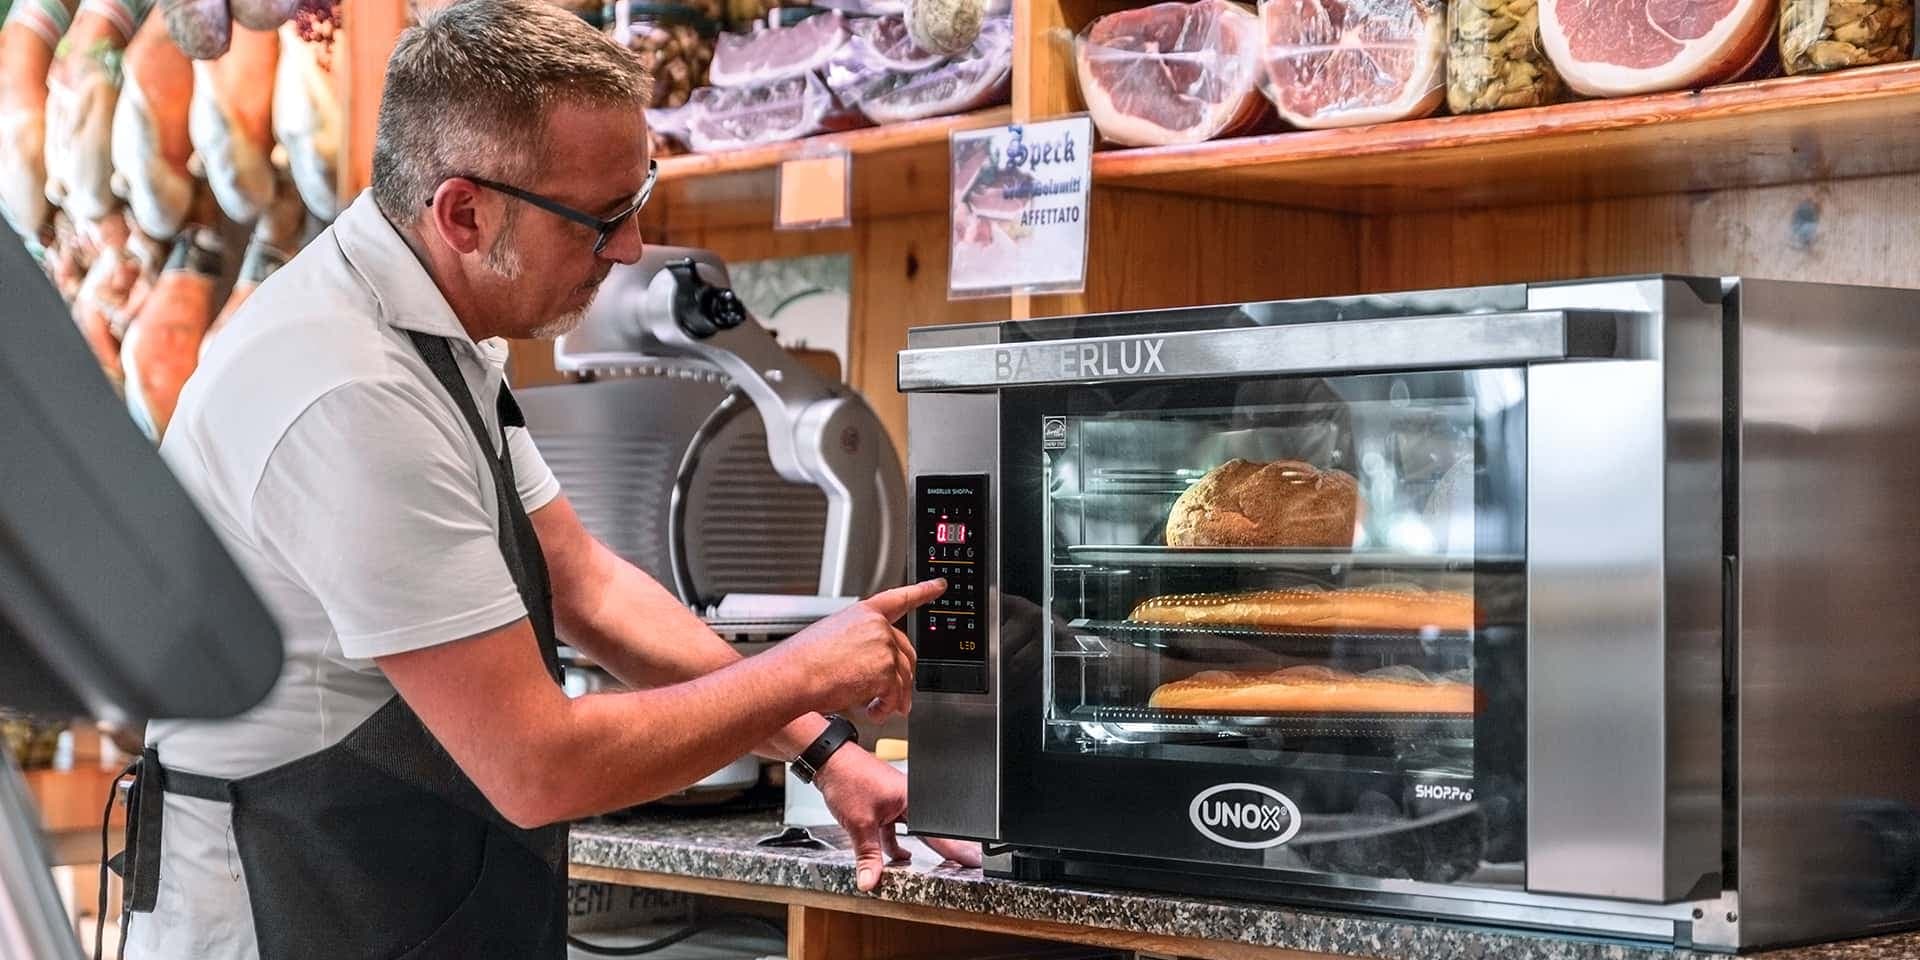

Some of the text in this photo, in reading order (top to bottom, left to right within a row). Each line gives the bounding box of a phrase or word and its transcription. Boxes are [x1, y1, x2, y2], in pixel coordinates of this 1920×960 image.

[1006, 125, 1075, 171] Speck
[1020, 206, 1080, 226] AFFETTATO
[995, 339, 1166, 382] BAERLUX
[959, 641, 975, 650] LED
